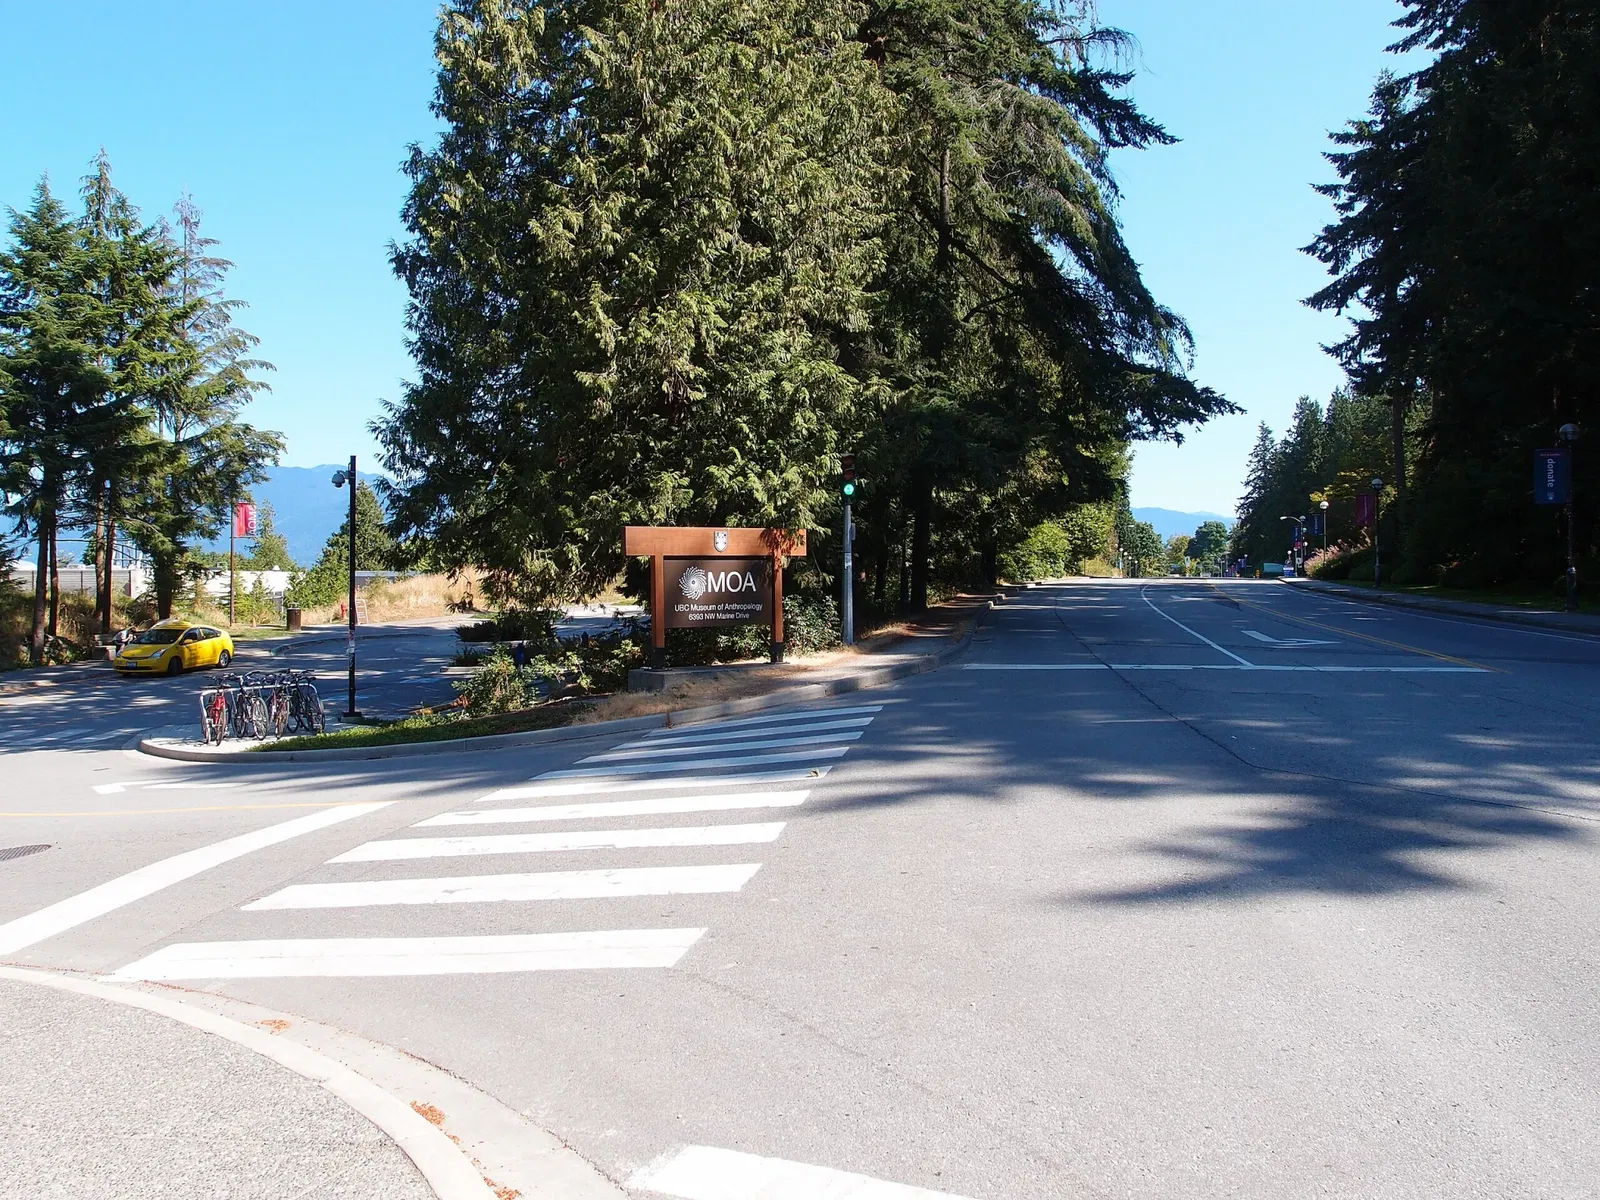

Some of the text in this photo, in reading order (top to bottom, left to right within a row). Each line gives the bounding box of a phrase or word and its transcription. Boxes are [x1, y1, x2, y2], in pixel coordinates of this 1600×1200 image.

[1547, 458, 1556, 488] donate
[707, 571, 757, 593] MOA
[674, 602, 763, 612] UBC Museum of Anthropology
[704, 612, 716, 620] NW
[716, 612, 735, 620] Marine
